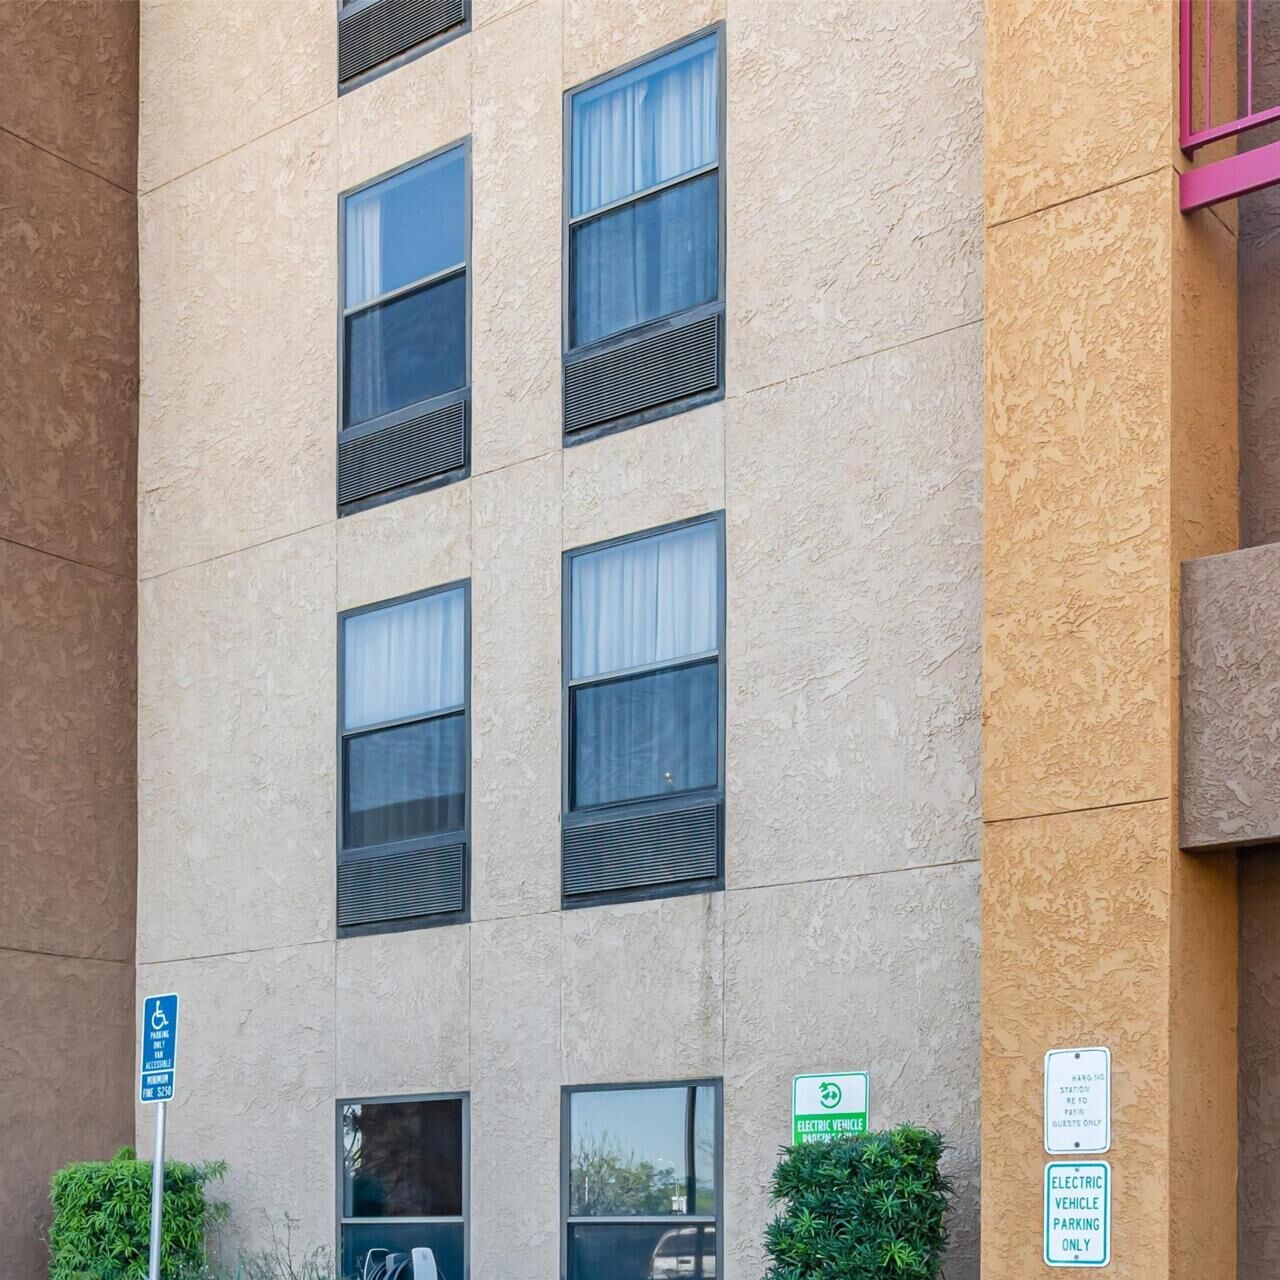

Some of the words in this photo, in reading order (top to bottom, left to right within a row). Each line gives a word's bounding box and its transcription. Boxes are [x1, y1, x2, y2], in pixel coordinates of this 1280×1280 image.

[150, 1030, 170, 1040] PARKING
[153, 1041, 166, 1050] ONLY
[145, 1059, 172, 1070] ACCESSIBLE
[143, 1087, 154, 1099] FINE
[797, 1119, 831, 1132] ELECTRIC
[833, 1118, 864, 1131] VEHICLE
[1052, 1119, 1081, 1128] GUESTS
[1083, 1119, 1102, 1127] ONLY
[1052, 1175, 1103, 1189] ELECTRIC
[1055, 1197, 1100, 1210] VEHICLE
[1053, 1218, 1100, 1231] PARKING
[1062, 1238, 1091, 1252] ONLY
